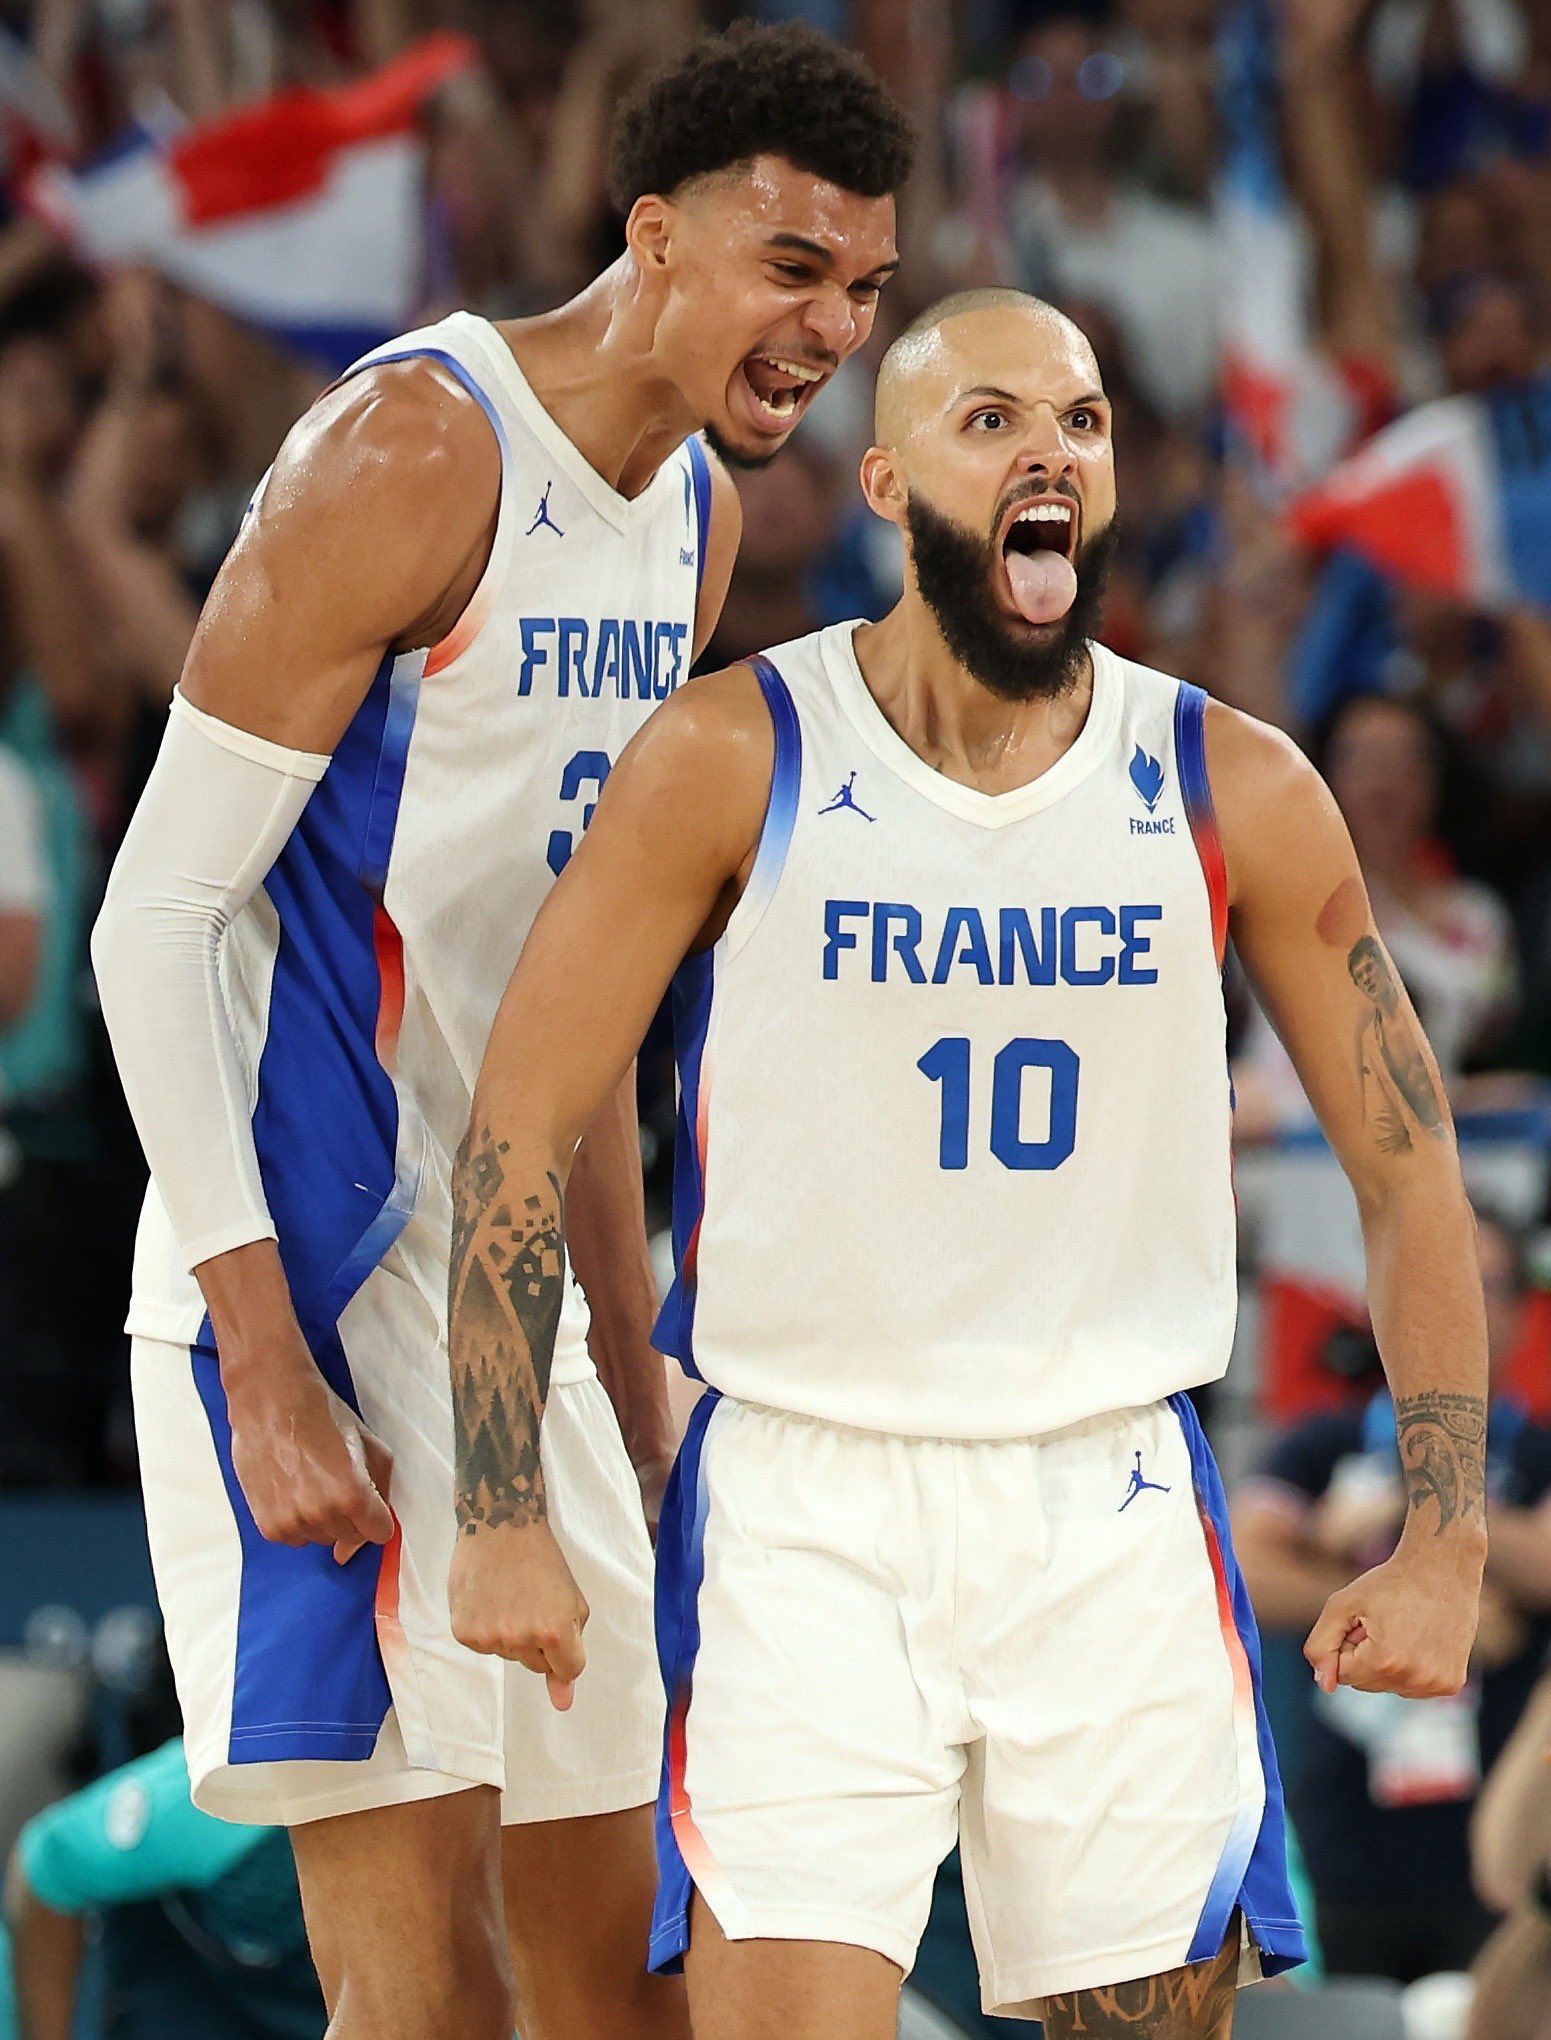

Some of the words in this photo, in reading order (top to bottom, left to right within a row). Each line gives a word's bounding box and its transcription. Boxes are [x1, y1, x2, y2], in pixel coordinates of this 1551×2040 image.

[518, 617, 688, 700] FRANCE
[1129, 817, 1175, 834] FRANCE
[823, 900, 1162, 986] FRANCE
[916, 1037, 1080, 1170] 10
